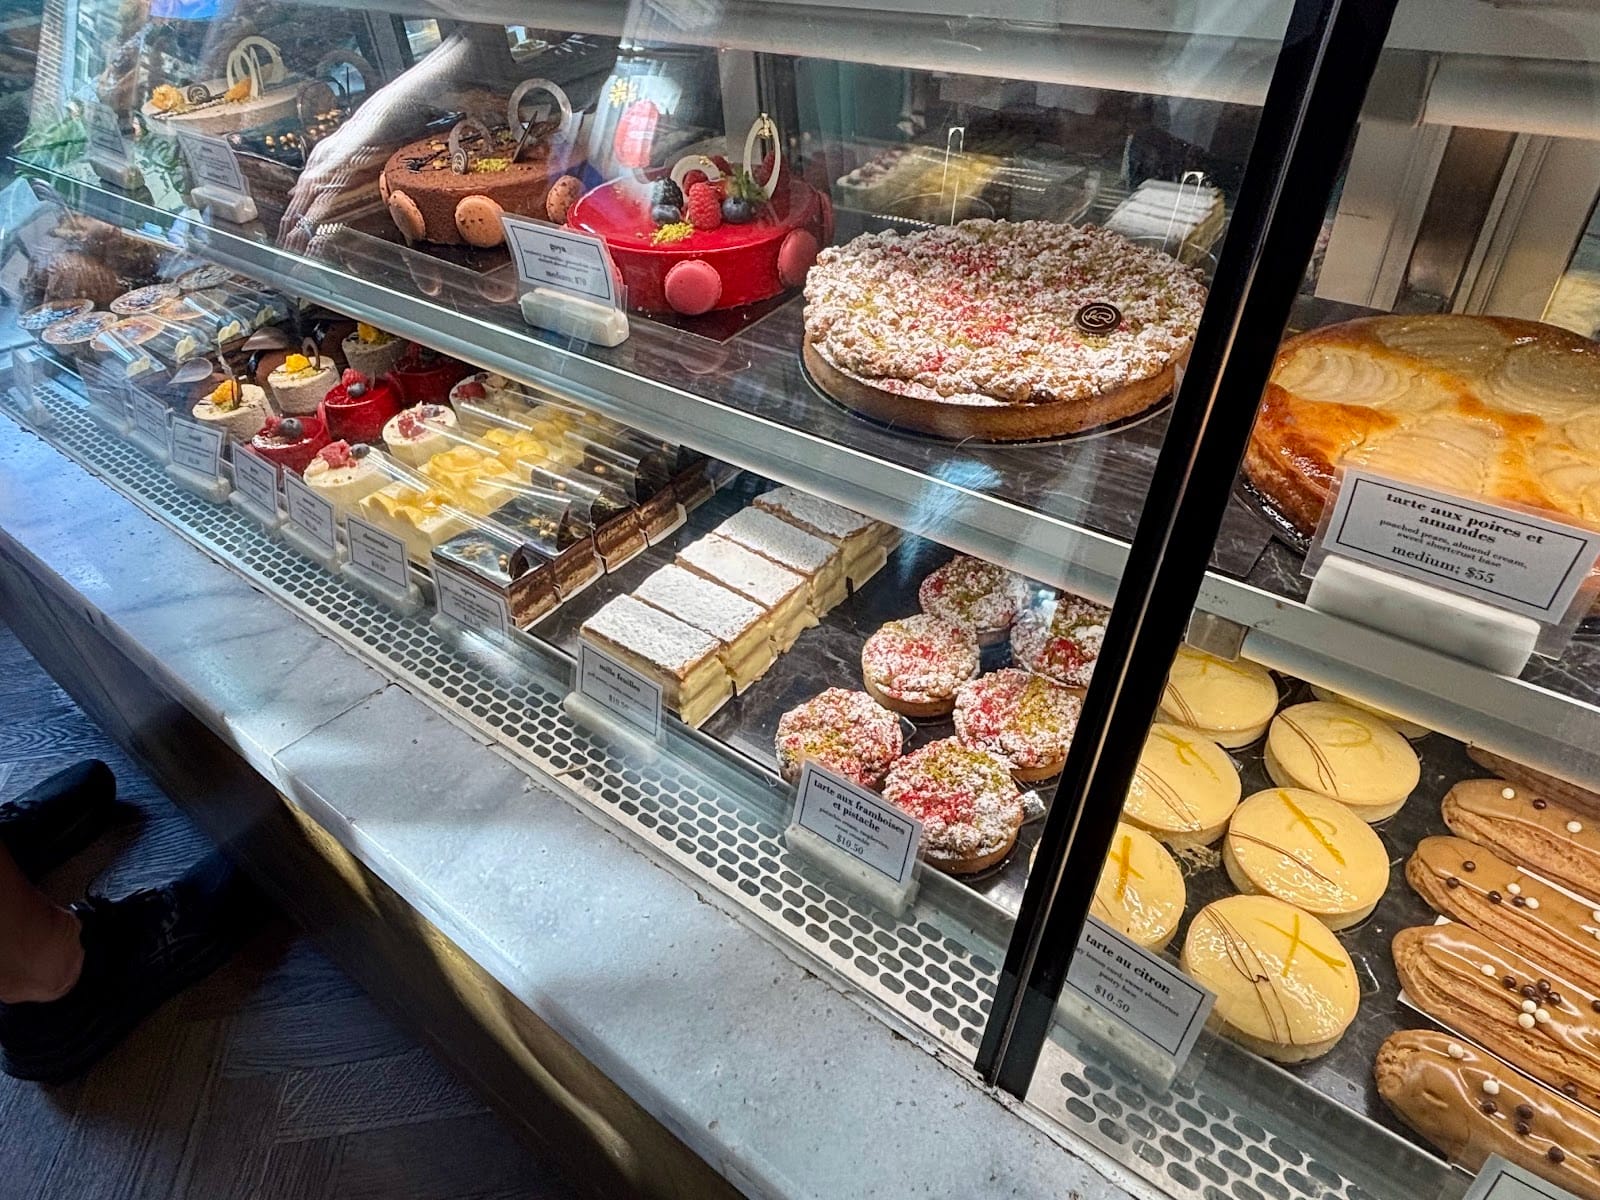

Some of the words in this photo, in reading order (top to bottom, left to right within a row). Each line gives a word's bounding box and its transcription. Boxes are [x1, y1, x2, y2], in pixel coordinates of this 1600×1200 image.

[1386, 493, 1427, 511] tarte
[1430, 507, 1463, 522] aux
[1466, 518, 1521, 538] poires
[1526, 534, 1544, 545] et
[1419, 516, 1496, 544] amandes
[1380, 519, 1420, 535] poached
[1420, 532, 1449, 545] pears,
[1452, 541, 1491, 557] almond
[1492, 554, 1527, 569] cream,
[1397, 532, 1423, 544] sweet
[1426, 541, 1476, 560] shortcrust
[1478, 556, 1501, 567] base
[1464, 567, 1496, 584] $55
[813, 779, 835, 796] tarte
[836, 792, 853, 806] aux
[855, 801, 905, 835] framboises
[832, 802, 841, 811] et
[842, 807, 880, 832] pistache
[835, 833, 864, 855] $10.50
[1085, 933, 1114, 957] tarte
[1115, 954, 1132, 970] au
[1134, 967, 1171, 995] citron
[1094, 984, 1130, 1013] $10.50
